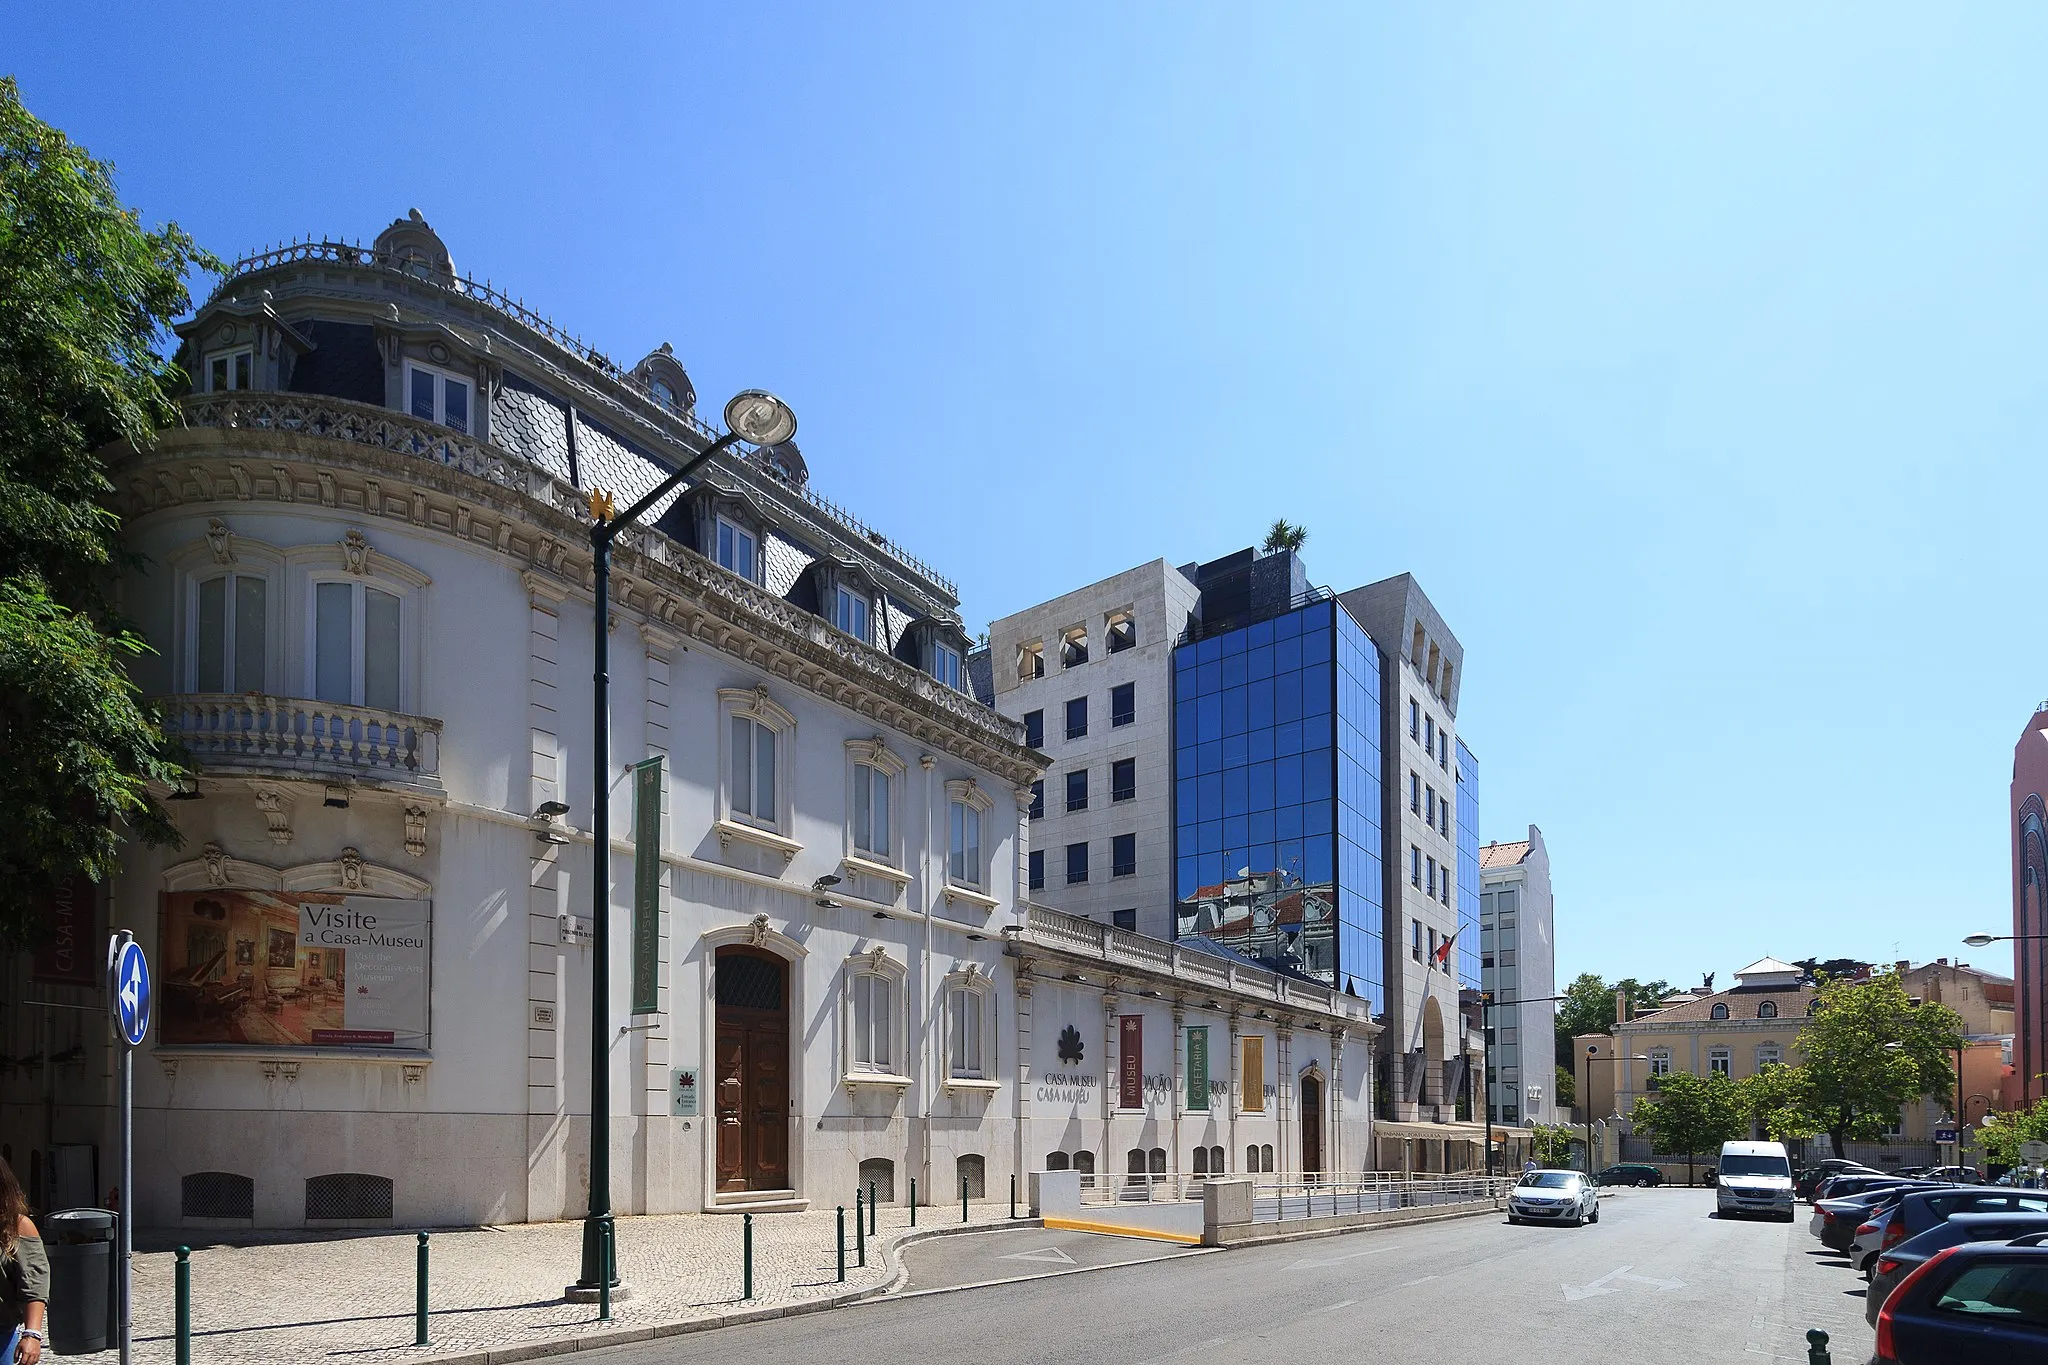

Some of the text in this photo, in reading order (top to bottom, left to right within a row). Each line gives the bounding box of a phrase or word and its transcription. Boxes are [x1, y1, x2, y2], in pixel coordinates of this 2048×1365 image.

[305, 906, 377, 930] Visite
[305, 929, 424, 949] a Casa-Museu
[641, 900, 652, 1003] CASA-MUSEU
[354, 973, 394, 982] Museum
[1045, 1072, 1097, 1088] CASA MUSEU
[1127, 1055, 1137, 1096] MUSEU
[1194, 1044, 1203, 1100] CAFETARIA
